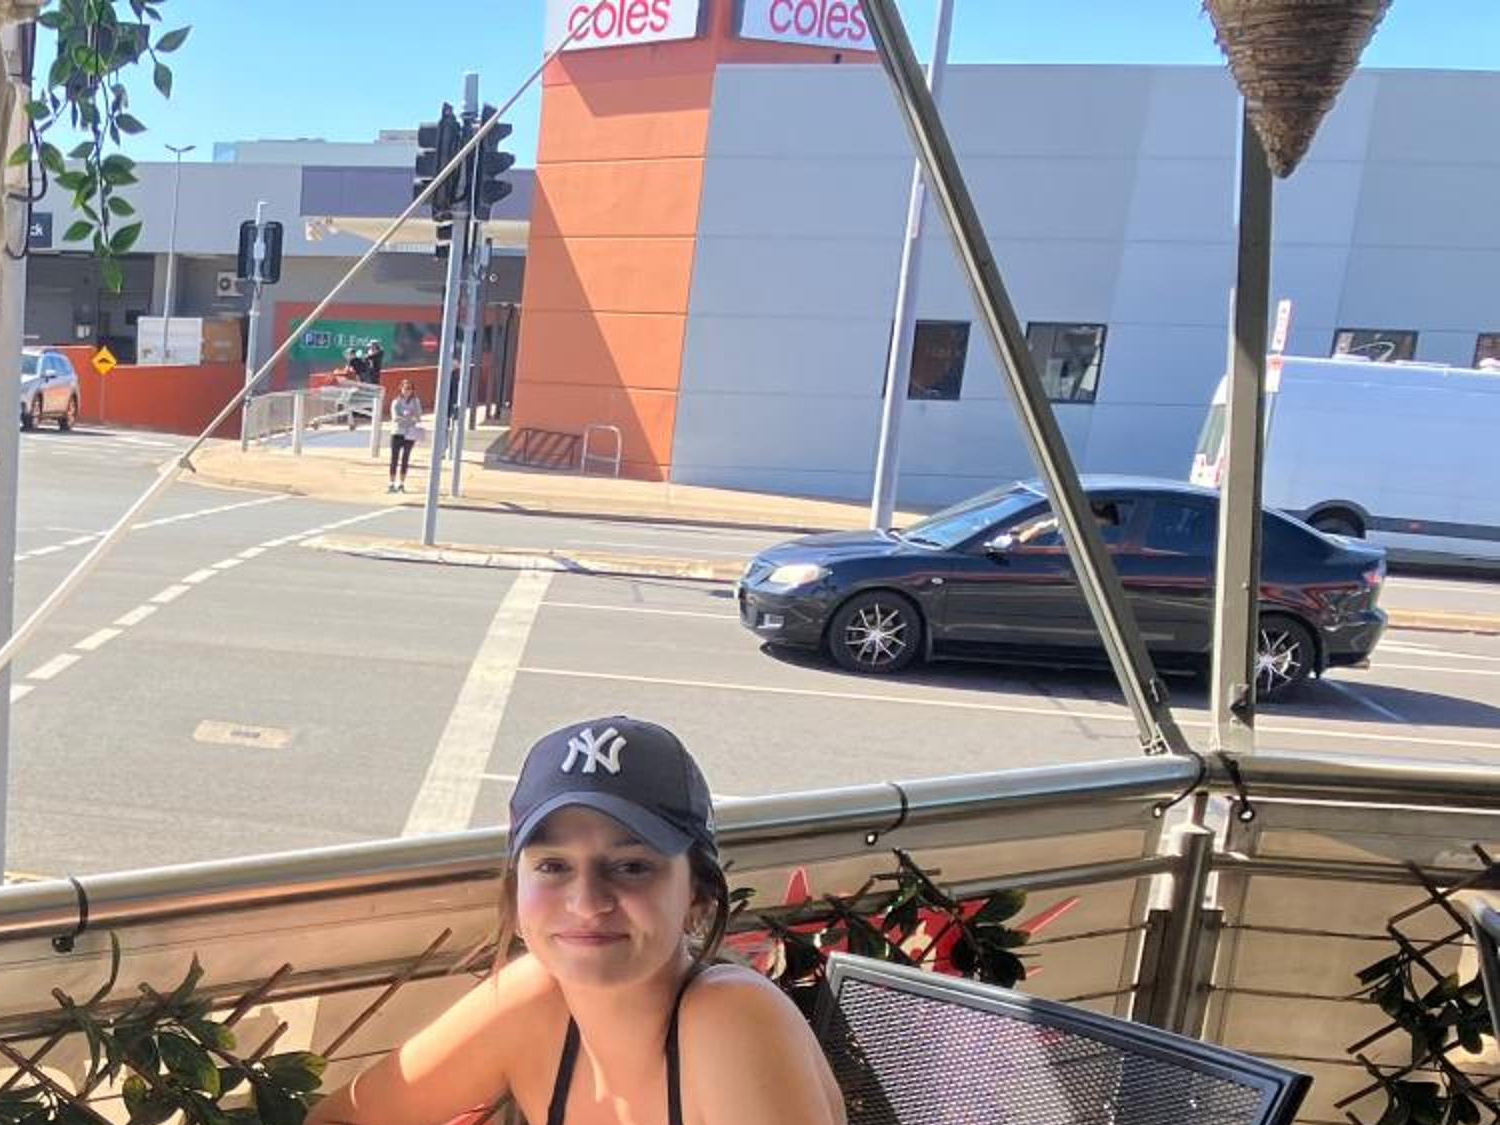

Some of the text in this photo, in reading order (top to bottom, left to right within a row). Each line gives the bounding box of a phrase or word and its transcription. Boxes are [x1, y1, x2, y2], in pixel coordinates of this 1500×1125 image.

[567, 0, 671, 40] coles
[769, 0, 867, 40] coles
[561, 727, 628, 774] NY
